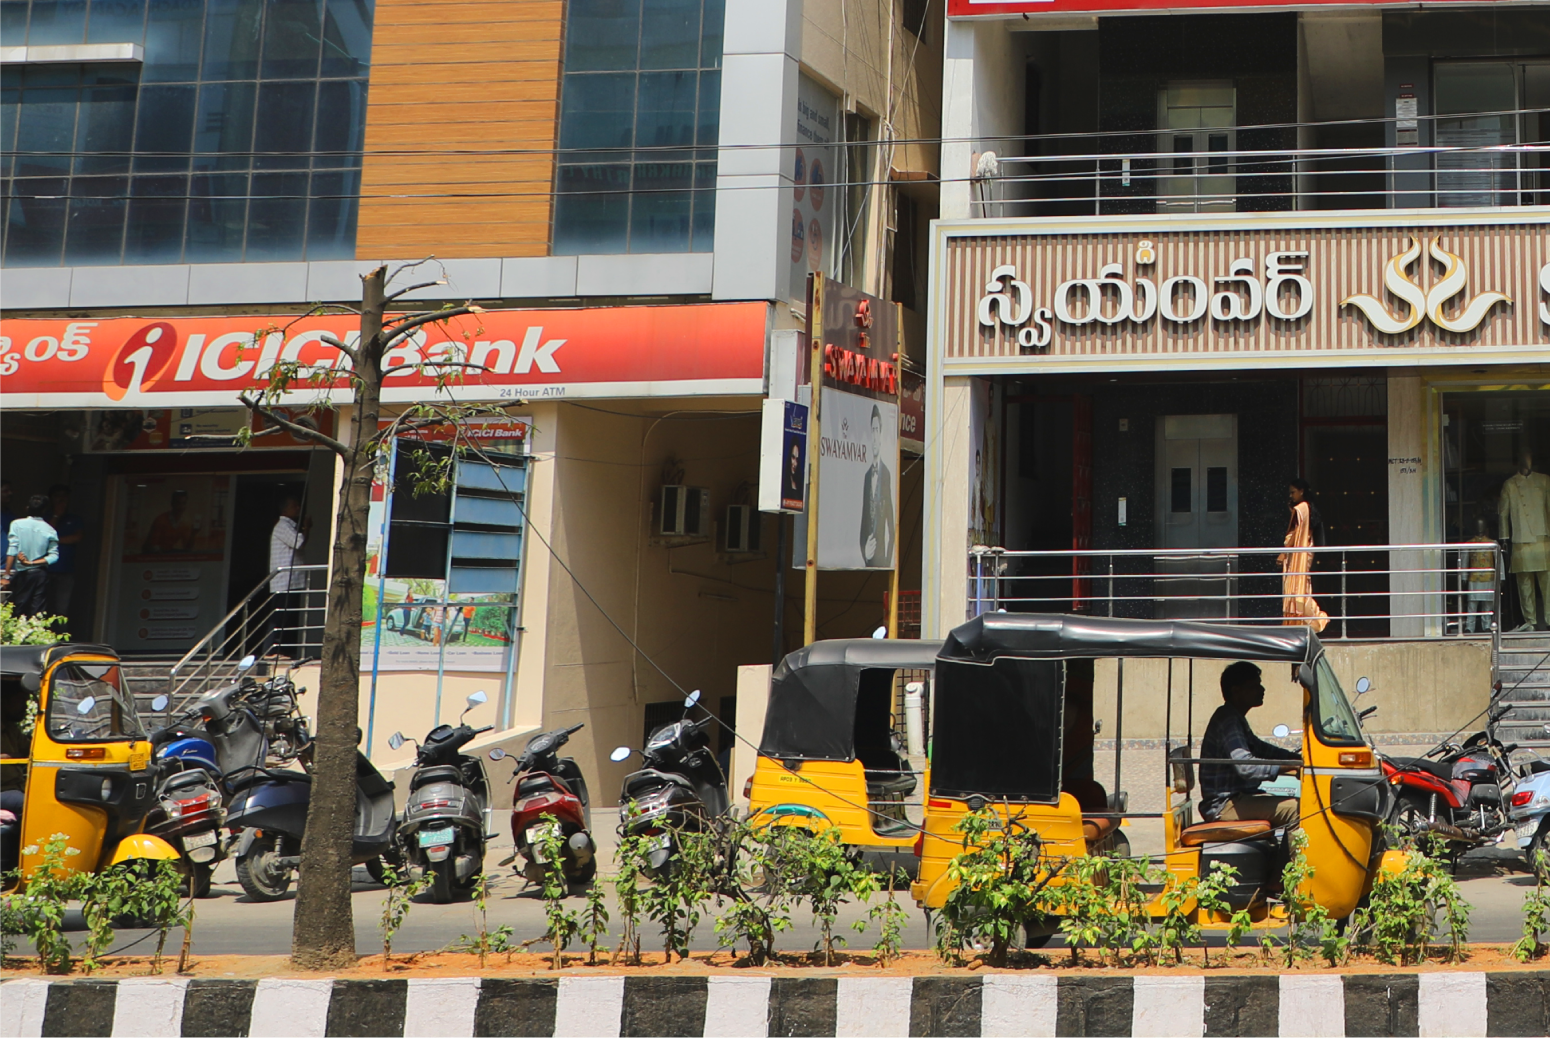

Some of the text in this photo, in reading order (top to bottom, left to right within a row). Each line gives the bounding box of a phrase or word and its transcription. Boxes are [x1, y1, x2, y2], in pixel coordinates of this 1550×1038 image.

[977, 249, 1314, 349] స్వయంవర్
[381, 326, 569, 379] Bank
[824, 343, 899, 395] SWAYAMVAR
[500, 386, 566, 398] 24 Hour ATM
[495, 428, 523, 438] Bank
[820, 436, 867, 462] SWAYAMVAR
